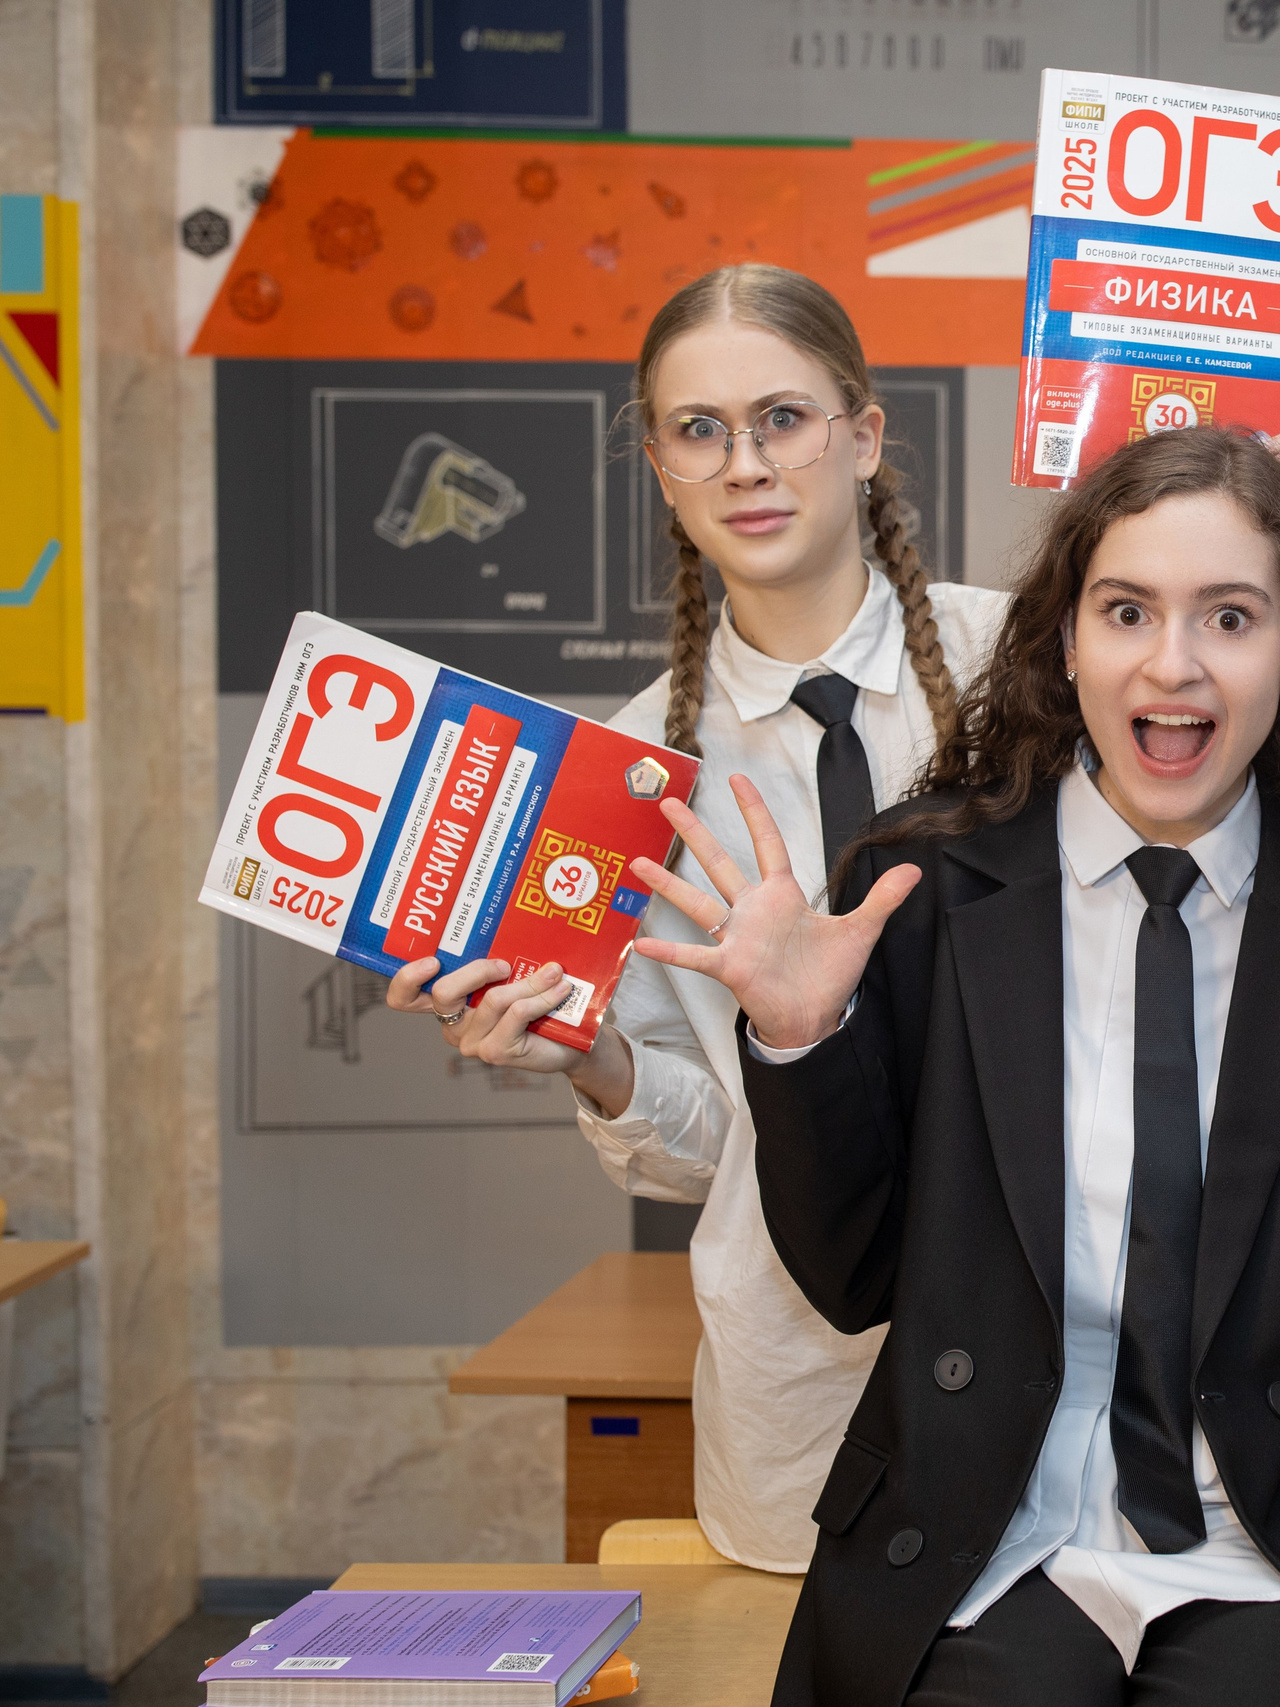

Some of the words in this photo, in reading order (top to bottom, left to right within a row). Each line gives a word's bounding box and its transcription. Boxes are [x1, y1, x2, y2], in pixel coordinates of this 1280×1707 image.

[1065, 103, 1101, 119] ФИПИ
[1115, 91, 1147, 104] ПРОЕКТ
[1152, 96, 1157, 105] С
[1162, 97, 1207, 111] УЧАСТИЕМ
[1065, 120, 1099, 131] ШКОЛЕ
[1060, 137, 1097, 210] 2025
[1085, 246, 1136, 260] ОСНОВНОЙ
[1140, 252, 1235, 272] ГОСУДАРСТВЕННЫЙ
[1238, 264, 1280, 277] ЭКЗАМЕН
[1103, 275, 1259, 320] ФИЗИКА
[1082, 321, 1125, 333] ТИПОВЫЕ
[1130, 326, 1220, 343] ЭКЗАМЕНАЦИОННЫЕ
[1225, 336, 1273, 349] ВАРИАНТЫ
[1102, 347, 1121, 357] ПОД
[1125, 349, 1182, 363] РЕДАКЦИЕЙ
[1204, 357, 1252, 370] КАМЗЕЕВОЙ
[1045, 398, 1080, 409] oge.plus
[1046, 390, 1081, 399] включи
[1154, 404, 1187, 428] 30
[301, 641, 314, 659] ОГЭ
[294, 660, 308, 681] КИМ
[267, 683, 300, 754] РАЗРАБОТЧИКОВ
[251, 755, 274, 801] УЧАСТИЕМ
[257, 654, 415, 878] ОГЭ
[248, 803, 257, 811] С
[235, 812, 254, 846] ПРОЕКТ
[378, 868, 403, 919] ОСНОВНОЙ
[397, 774, 439, 868] ГОСУДАРСТВЕННЫЙ
[432, 728, 455, 774] ЭКЗАМЕН
[404, 818, 470, 936] РУССКИЙ
[450, 737, 501, 816] ЯЗЫК
[449, 900, 472, 943] ТИПОВЫЕ
[466, 808, 507, 900] ЭКЗАМЕНАЦИОННЫЕ
[501, 758, 526, 807] ВАРИАНТЫ
[479, 915, 493, 935] ПОД
[487, 857, 514, 914] РЕДАКЦИЕЙ
[516, 783, 542, 839] ДОЩИНСКОГО
[238, 859, 259, 897] ФИПИ
[251, 867, 269, 900] ШКОЛЕ
[552, 865, 583, 897] 36
[576, 870, 592, 902] ВАРИАНТОВ
[269, 876, 344, 927] 2025
